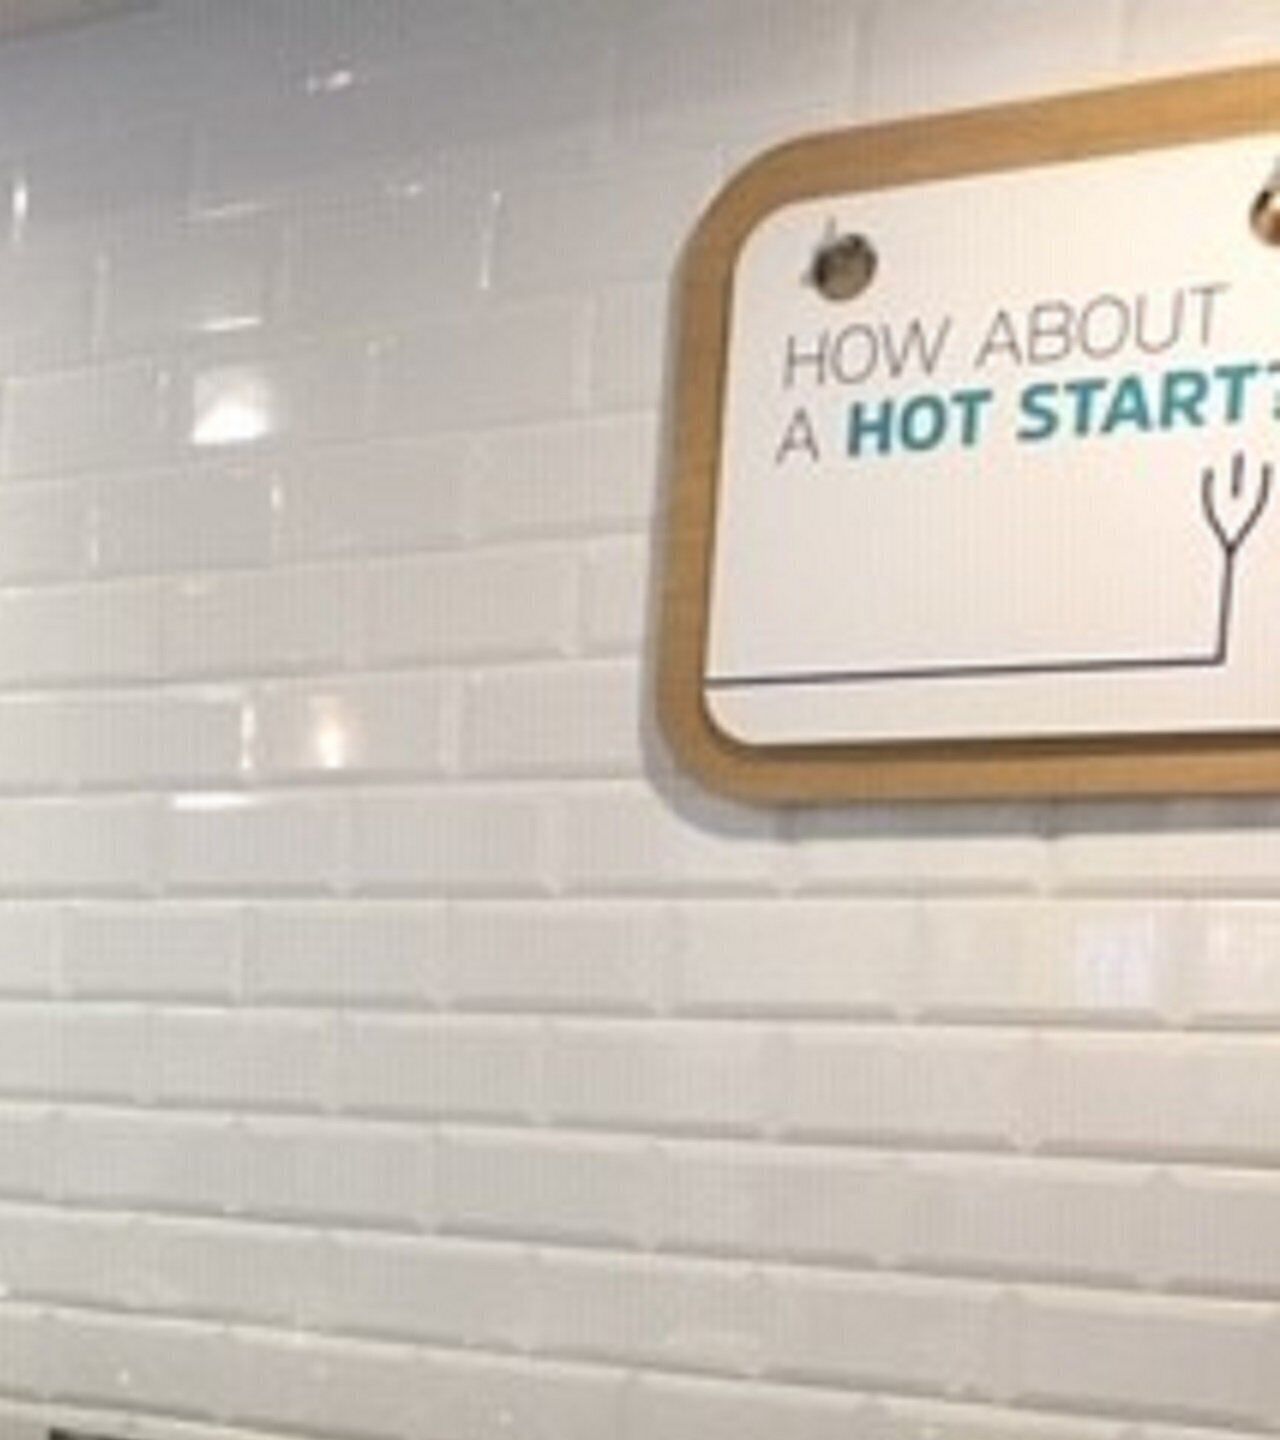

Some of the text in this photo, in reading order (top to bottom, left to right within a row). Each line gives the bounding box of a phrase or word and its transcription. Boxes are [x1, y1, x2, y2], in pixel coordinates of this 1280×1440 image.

[783, 283, 1231, 389] HOW ABOUT
[774, 406, 820, 465] A
[846, 388, 993, 457] HOT
